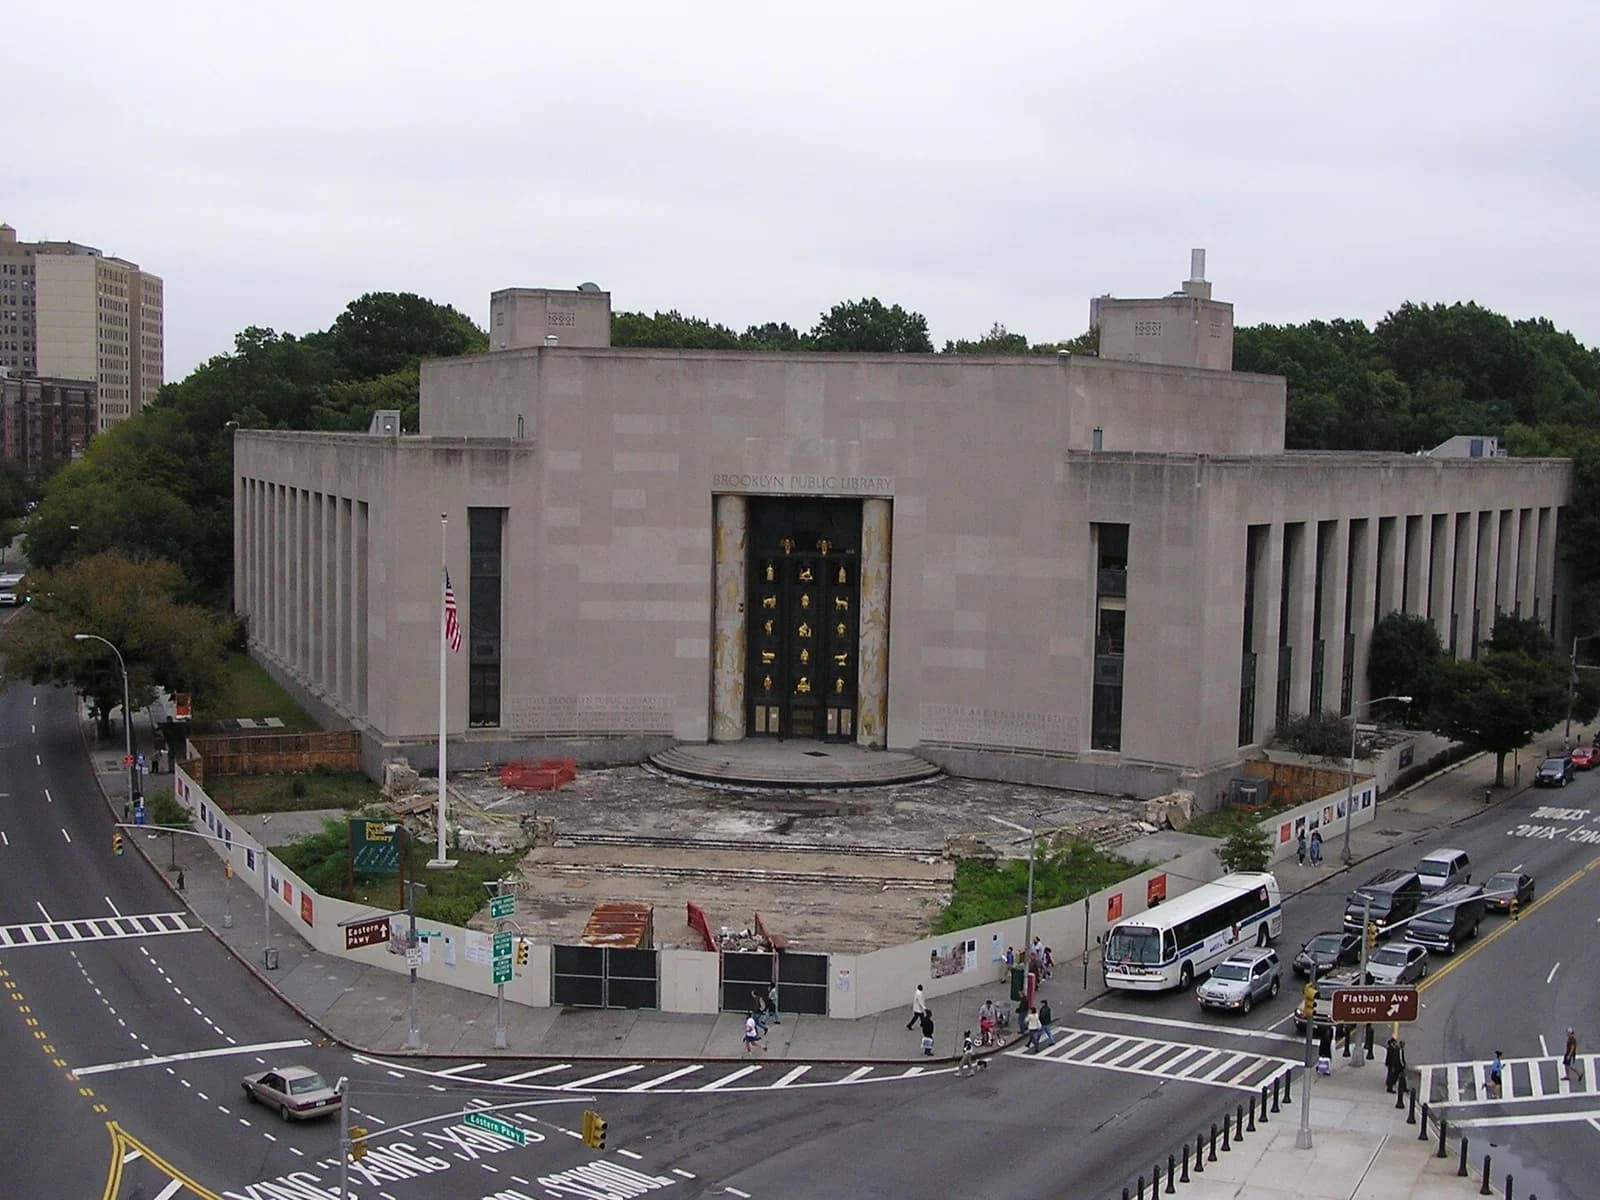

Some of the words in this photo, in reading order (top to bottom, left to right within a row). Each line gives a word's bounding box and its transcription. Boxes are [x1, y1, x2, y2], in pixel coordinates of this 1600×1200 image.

[713, 474, 784, 488] BROOKLYN
[790, 476, 836, 489] PUBLIC
[841, 477, 893, 490] LIBRARY
[348, 924, 379, 937] Eastern
[1342, 993, 1386, 1003] Flatbush
[1390, 993, 1409, 1003] Ave
[1350, 1007, 1377, 1015] SOUTH
[470, 1113, 499, 1132] Eastern
[347, 1142, 451, 1187] XING
[537, 1159, 677, 1200] SCHOOL
